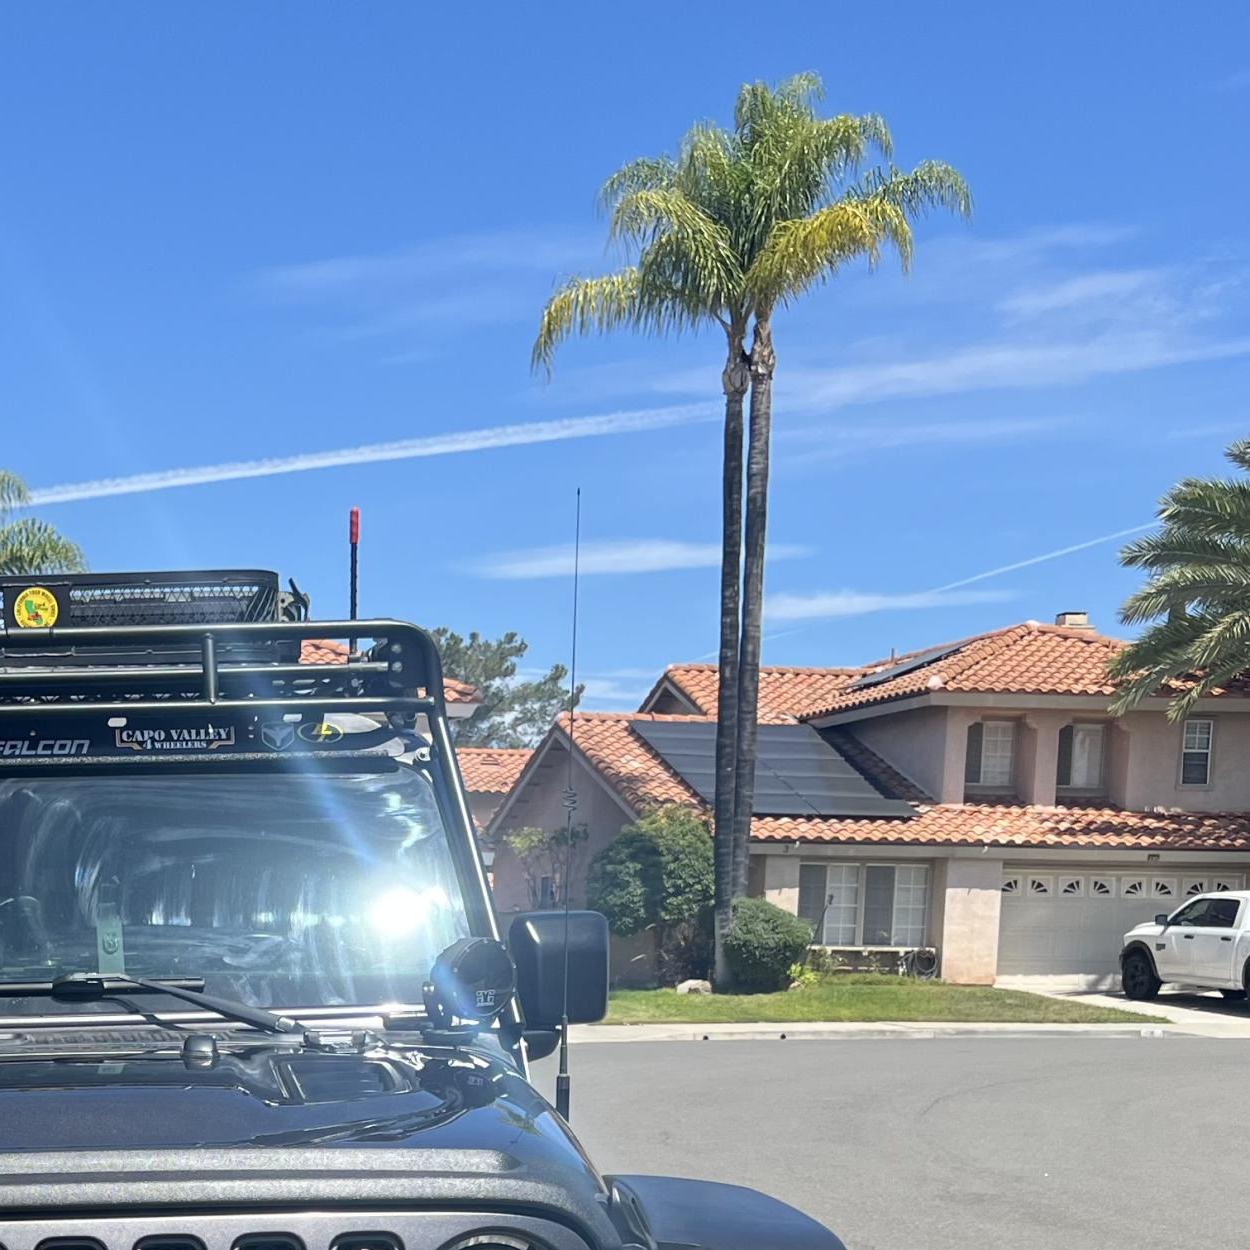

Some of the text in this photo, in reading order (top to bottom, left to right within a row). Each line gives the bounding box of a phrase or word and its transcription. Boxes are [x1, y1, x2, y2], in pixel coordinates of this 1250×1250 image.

[121, 727, 229, 742] CAPO VALLEY
[143, 739, 207, 750] 4 WHEELERS
